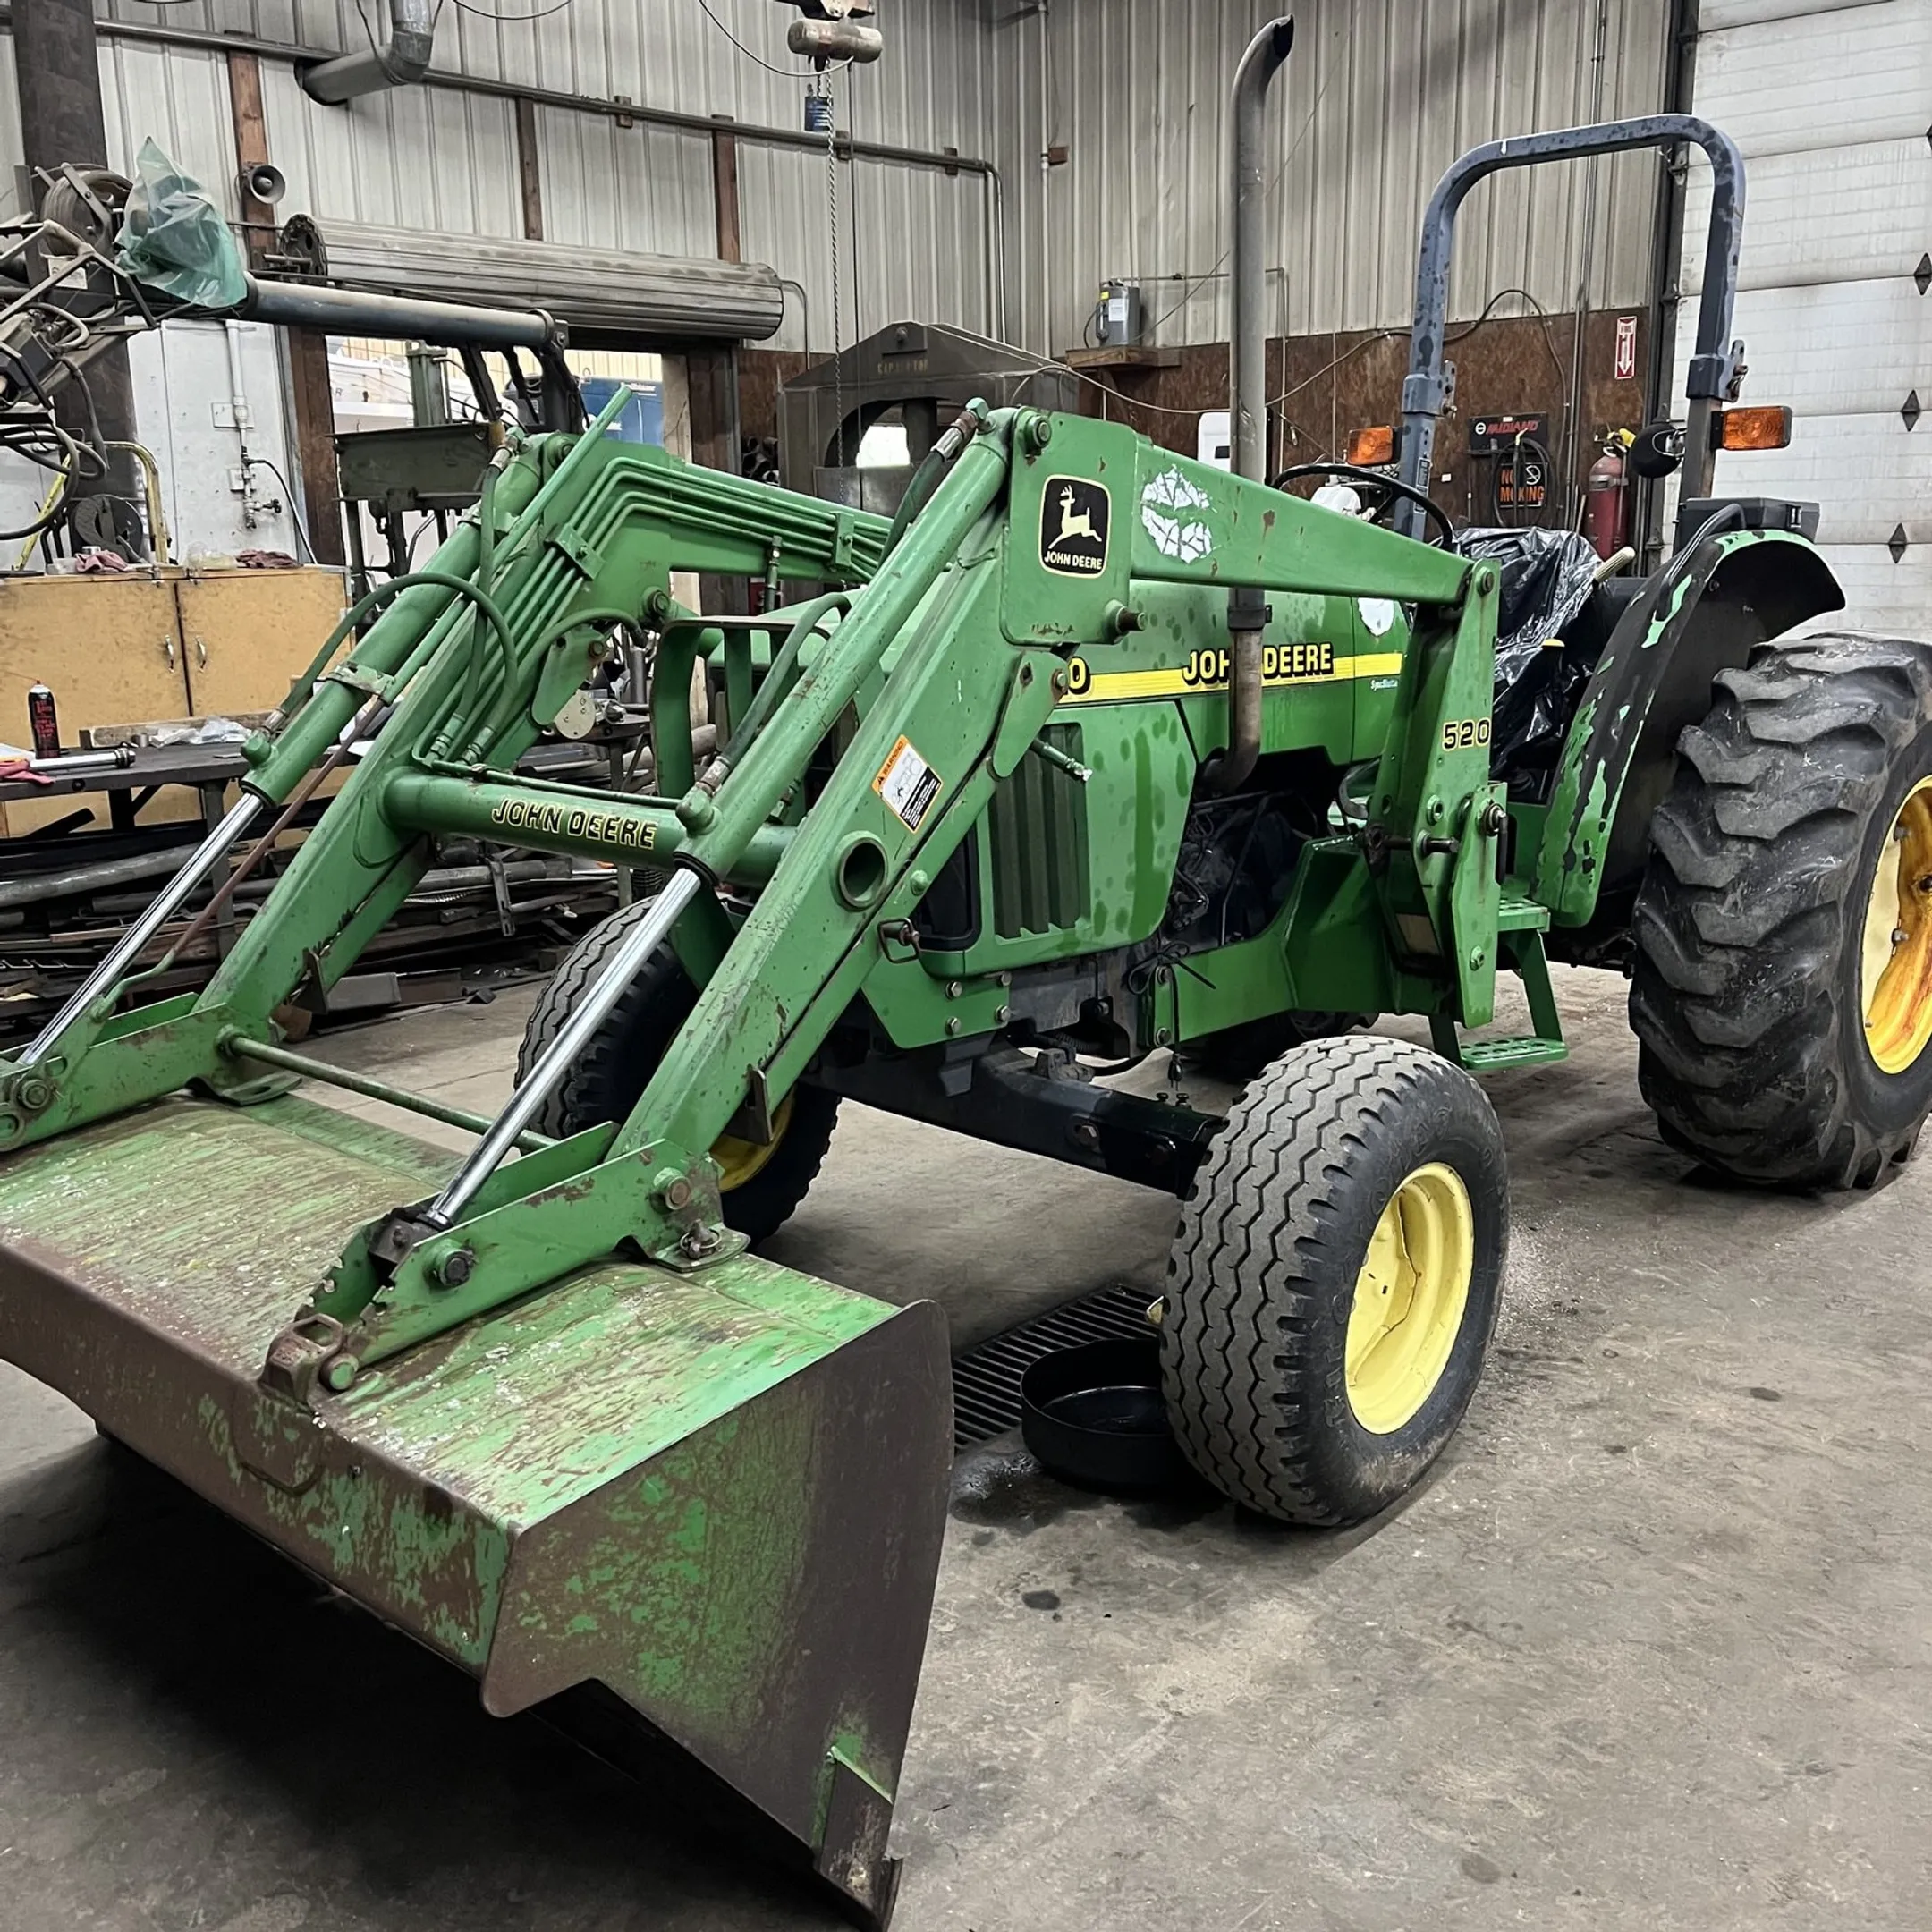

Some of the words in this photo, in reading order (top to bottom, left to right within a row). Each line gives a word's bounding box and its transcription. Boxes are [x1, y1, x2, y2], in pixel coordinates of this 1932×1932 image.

[1044, 551, 1071, 565] JOHN
[1072, 555, 1102, 570] DEERE
[1183, 649, 1230, 684] JOH
[1262, 642, 1333, 678] DEERE
[1442, 717, 1491, 751] 520
[492, 796, 564, 834] JOHN
[567, 809, 659, 850] DEERE
